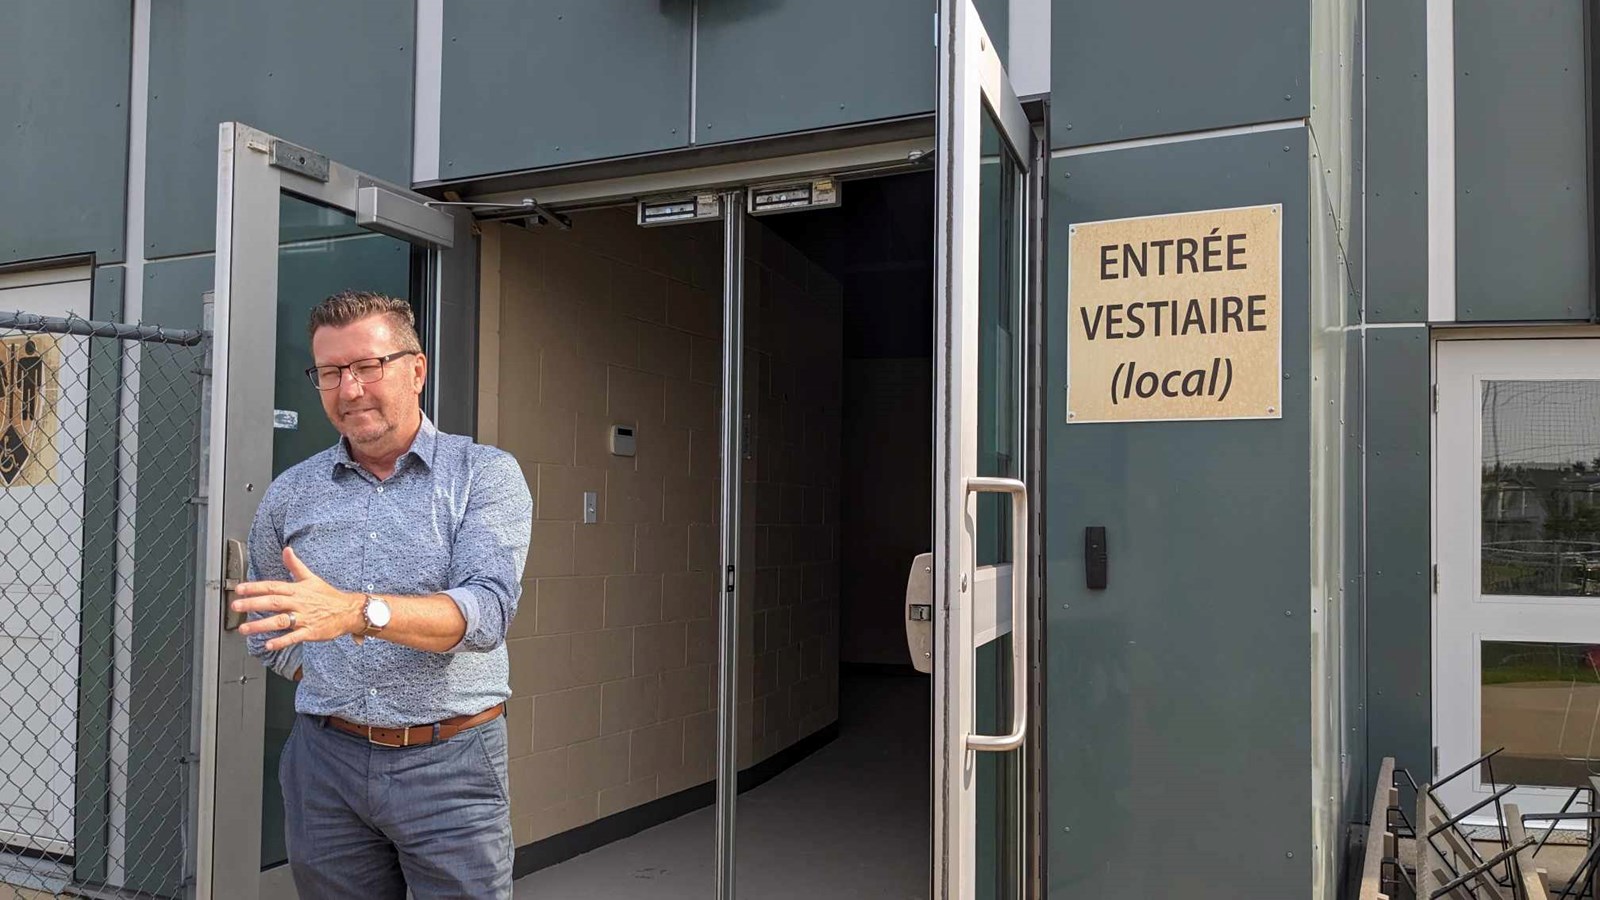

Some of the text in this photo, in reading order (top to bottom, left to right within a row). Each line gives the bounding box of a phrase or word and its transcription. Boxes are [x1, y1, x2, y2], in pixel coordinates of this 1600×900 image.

[1100, 227, 1247, 281] ENTRÉE
[1080, 294, 1267, 341] VESTIAIRE
[1111, 357, 1233, 405] (local)
